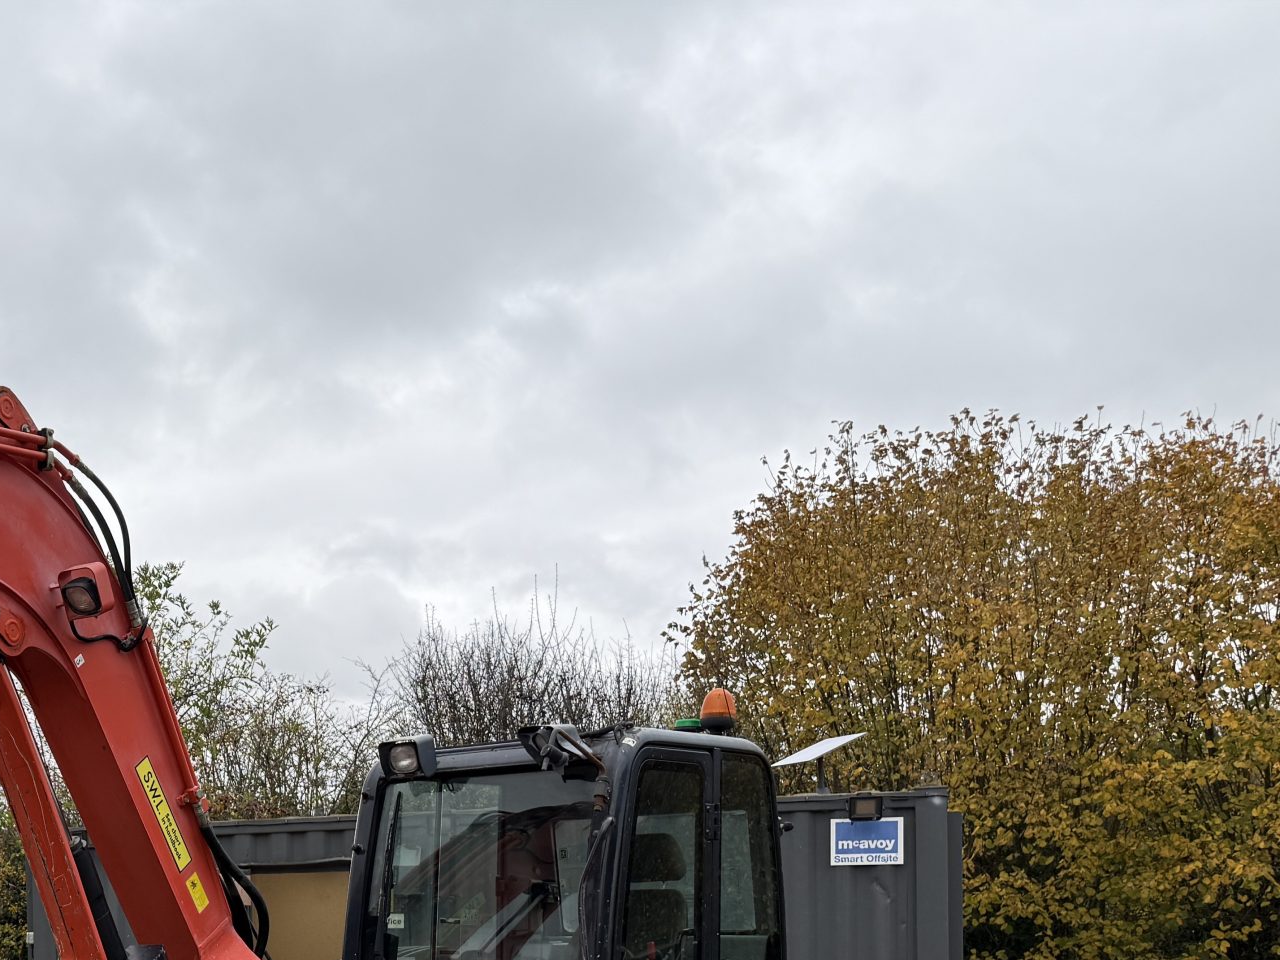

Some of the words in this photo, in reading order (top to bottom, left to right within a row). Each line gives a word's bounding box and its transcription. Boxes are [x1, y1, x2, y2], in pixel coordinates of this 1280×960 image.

[165, 825, 181, 860] handbook
[834, 855, 864, 863] Smart
[866, 854, 899, 863] Offsite
